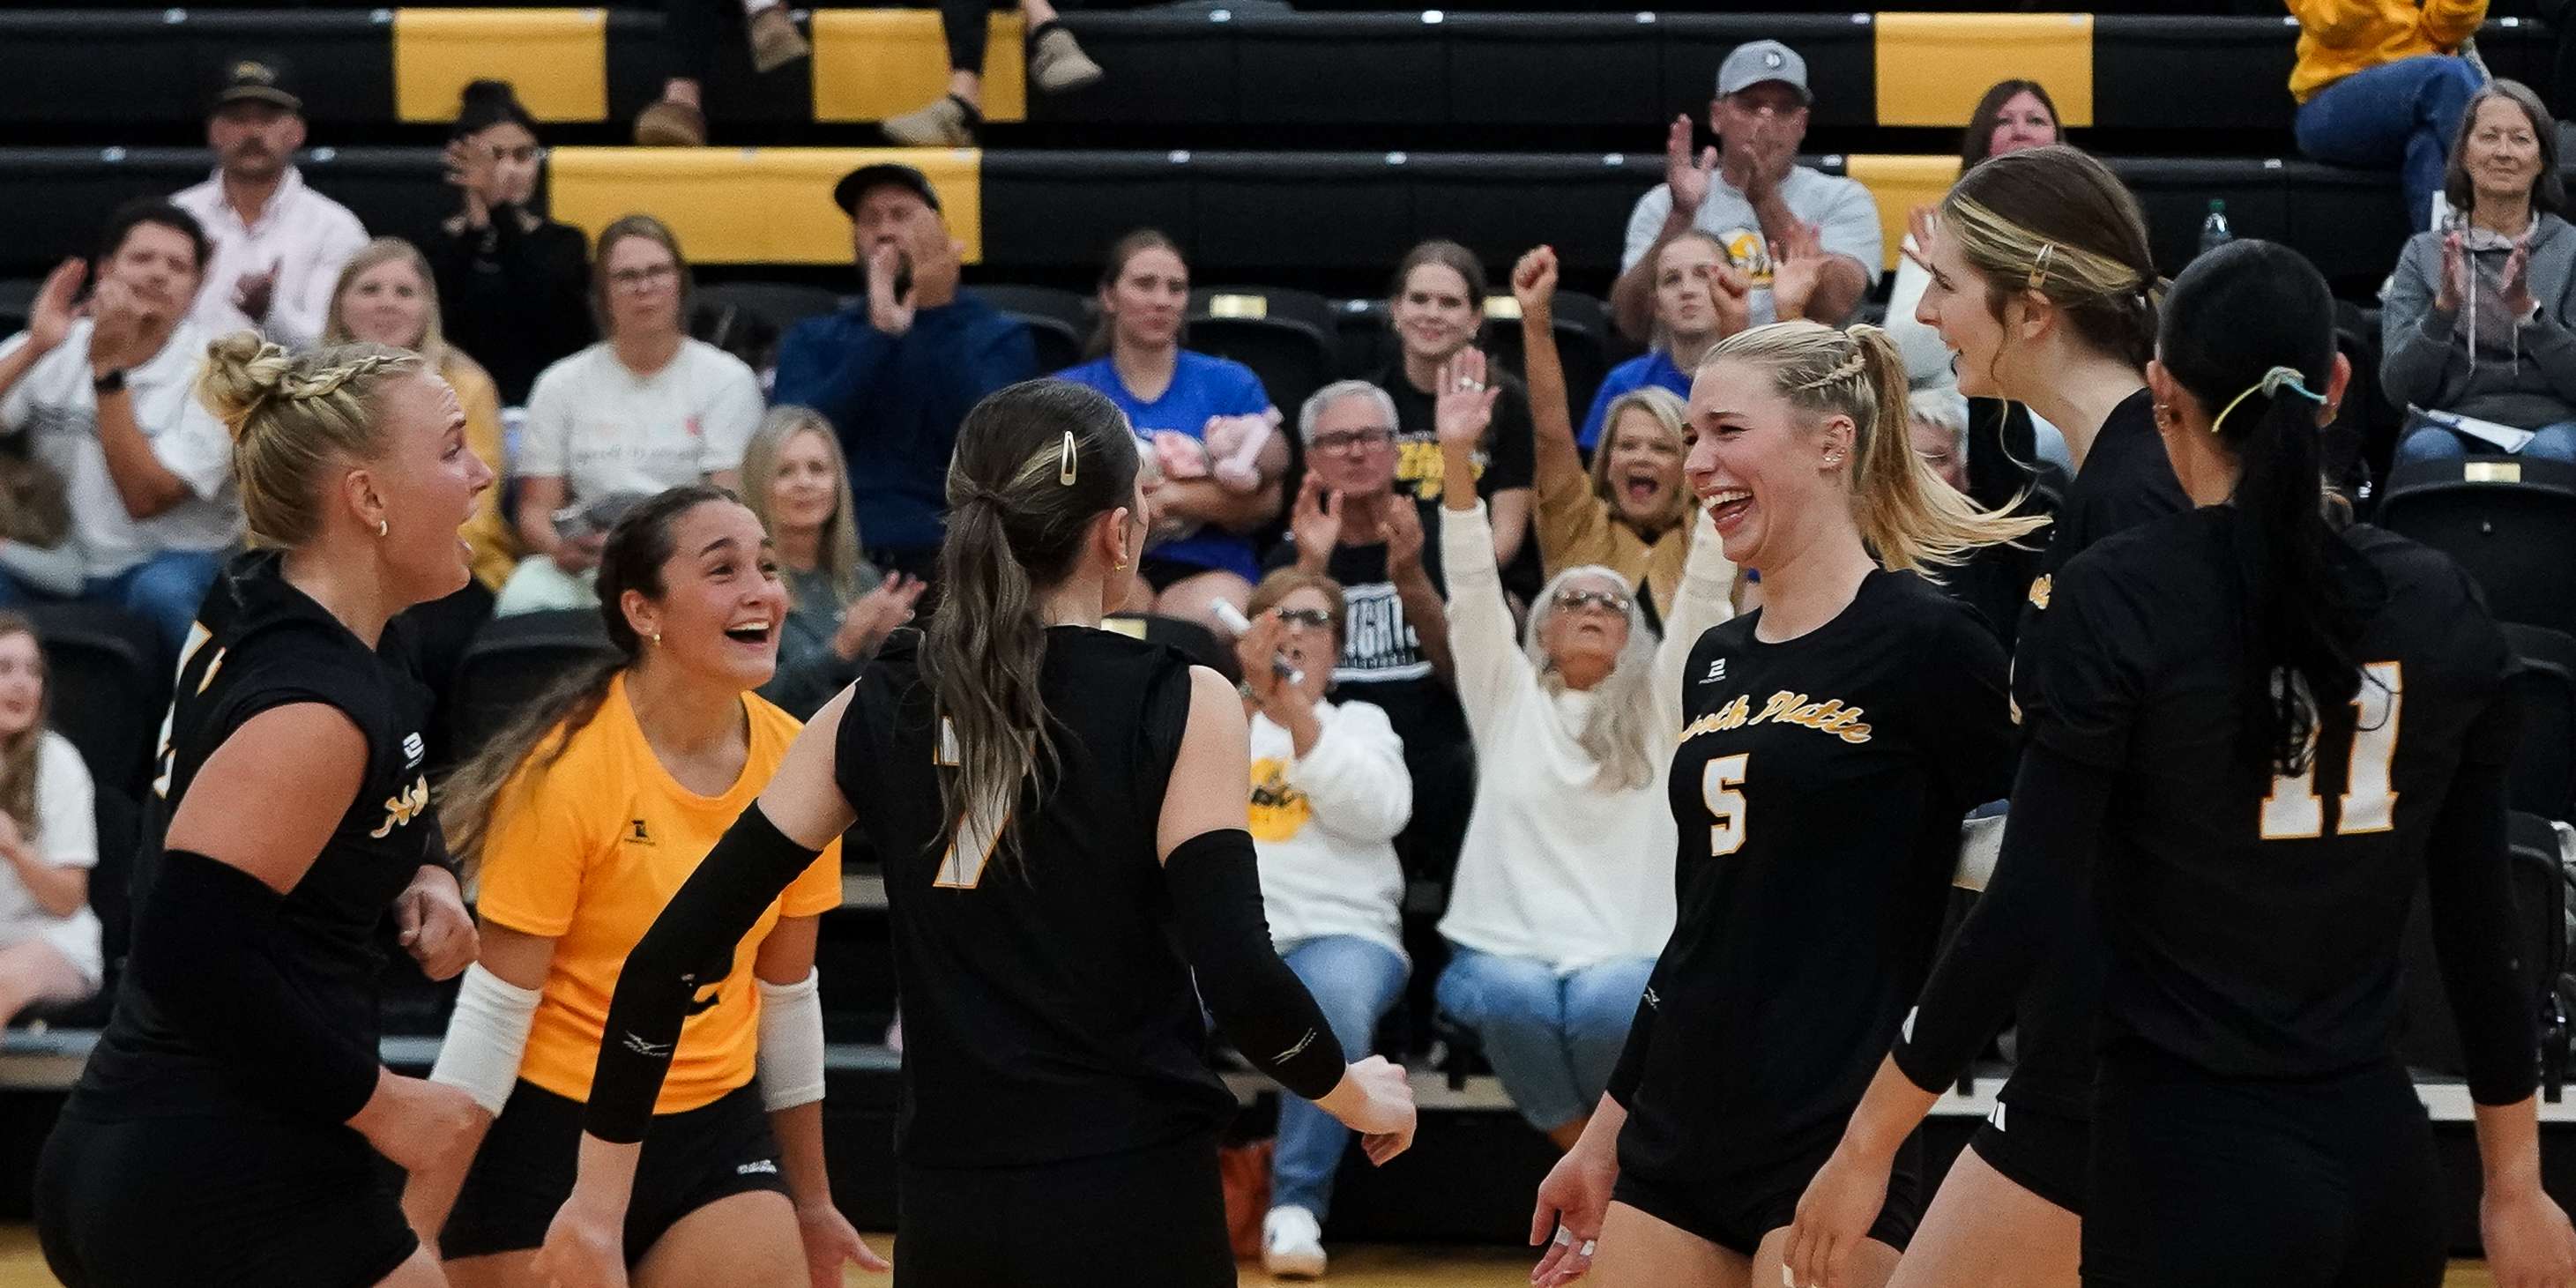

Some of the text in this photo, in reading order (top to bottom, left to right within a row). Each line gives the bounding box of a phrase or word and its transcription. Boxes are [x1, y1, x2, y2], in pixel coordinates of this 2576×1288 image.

[1748, 689, 1872, 743] Platte
[2260, 660, 2404, 840] 11
[933, 716, 1038, 889] 7
[1701, 752, 1750, 857] 5
